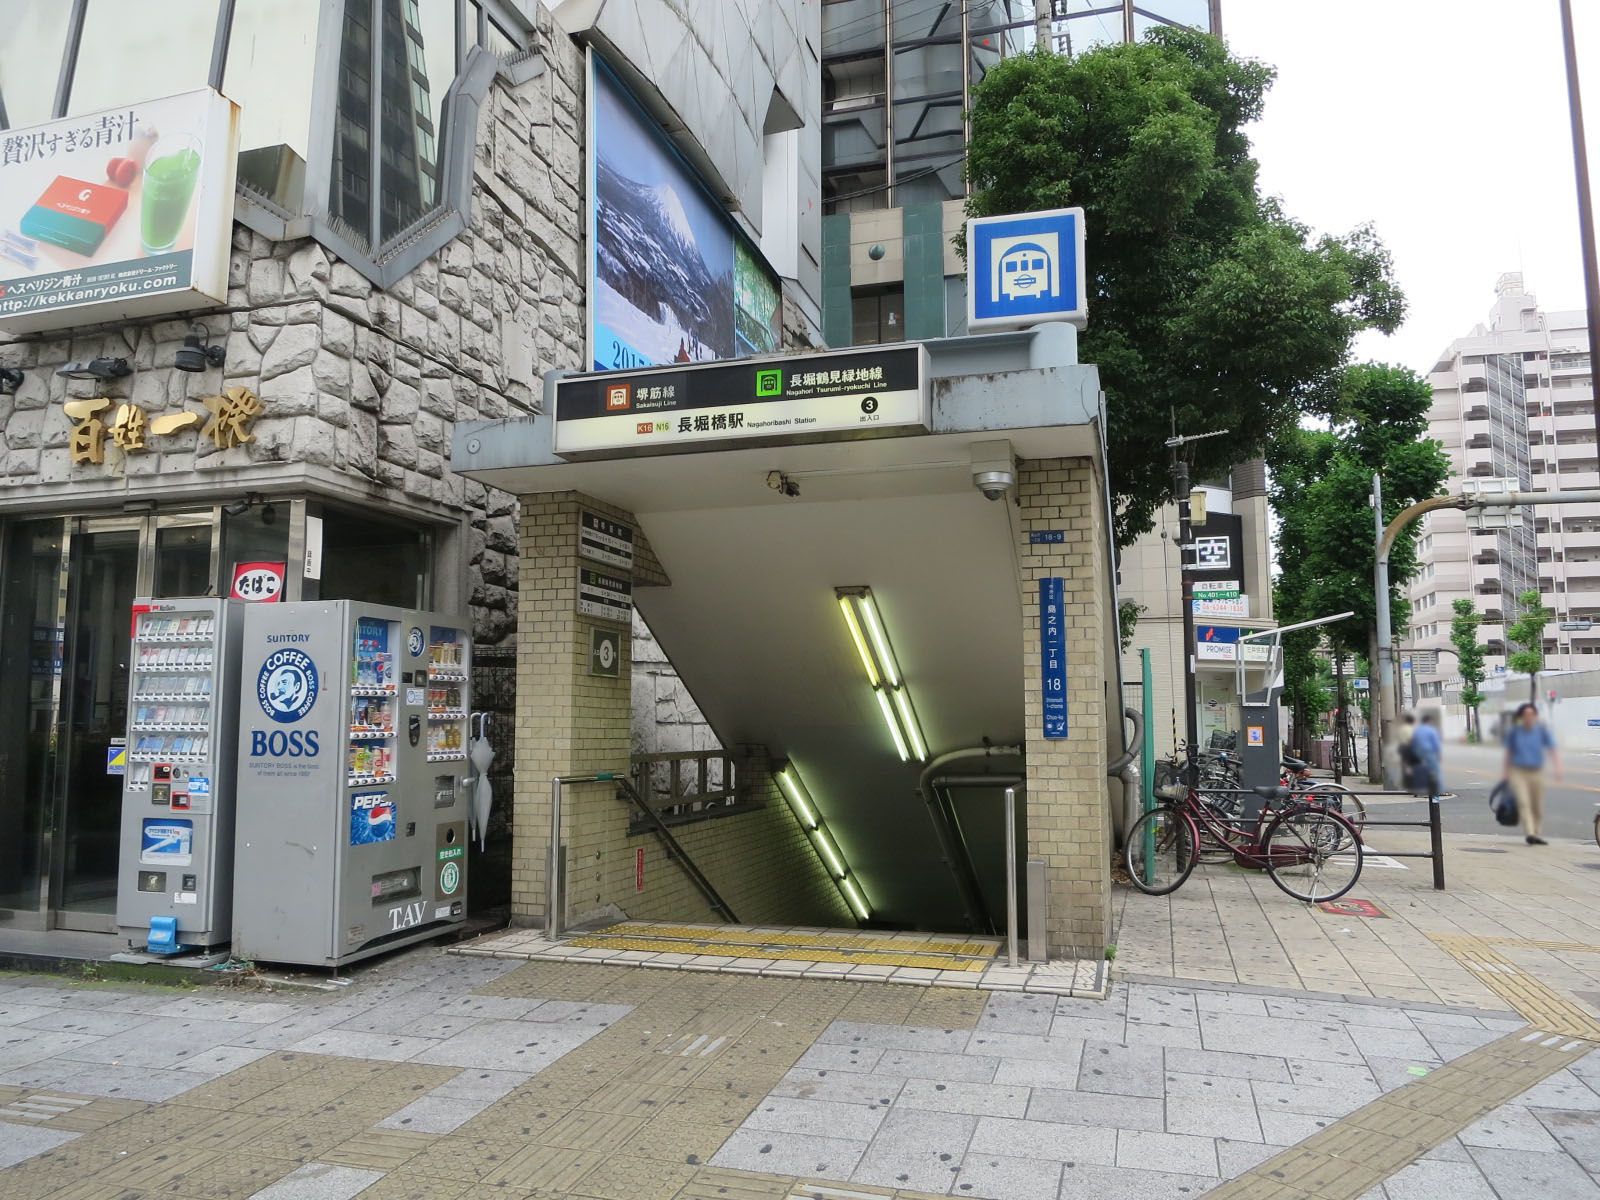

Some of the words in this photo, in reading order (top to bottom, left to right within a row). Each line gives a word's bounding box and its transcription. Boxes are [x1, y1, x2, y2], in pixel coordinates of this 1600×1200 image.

[2, 111, 139, 167] 贅沢すぎる青汁
[790, 366, 883, 388] 長堀鶴見緑地線
[636, 386, 676, 401] 堺筋線
[786, 388, 814, 396] Nagahori
[816, 382, 871, 394] Tsurumi-ryokuchi
[873, 381, 888, 389] Line
[635, 401, 663, 409] Sakaisuji
[637, 423, 653, 433] K16
[655, 421, 670, 431] N16
[677, 412, 744, 433] 長堀橋駅
[746, 418, 792, 429] Nagahoribashi
[794, 416, 817, 425] Station
[860, 414, 880, 422] 出入口
[238, 573, 276, 595] たばこ
[266, 633, 311, 643] SUNTORY
[1047, 604, 1058, 669] 島之内一丁目
[1206, 645, 1233, 654] PROMISE
[266, 651, 311, 671] COFFEE
[258, 670, 270, 699] COFFEE
[305, 669, 316, 690] BOSS
[1046, 677, 1061, 691] 18
[261, 699, 276, 717] BOSS
[297, 691, 316, 717] COFFEE
[250, 729, 320, 757] BOSS
